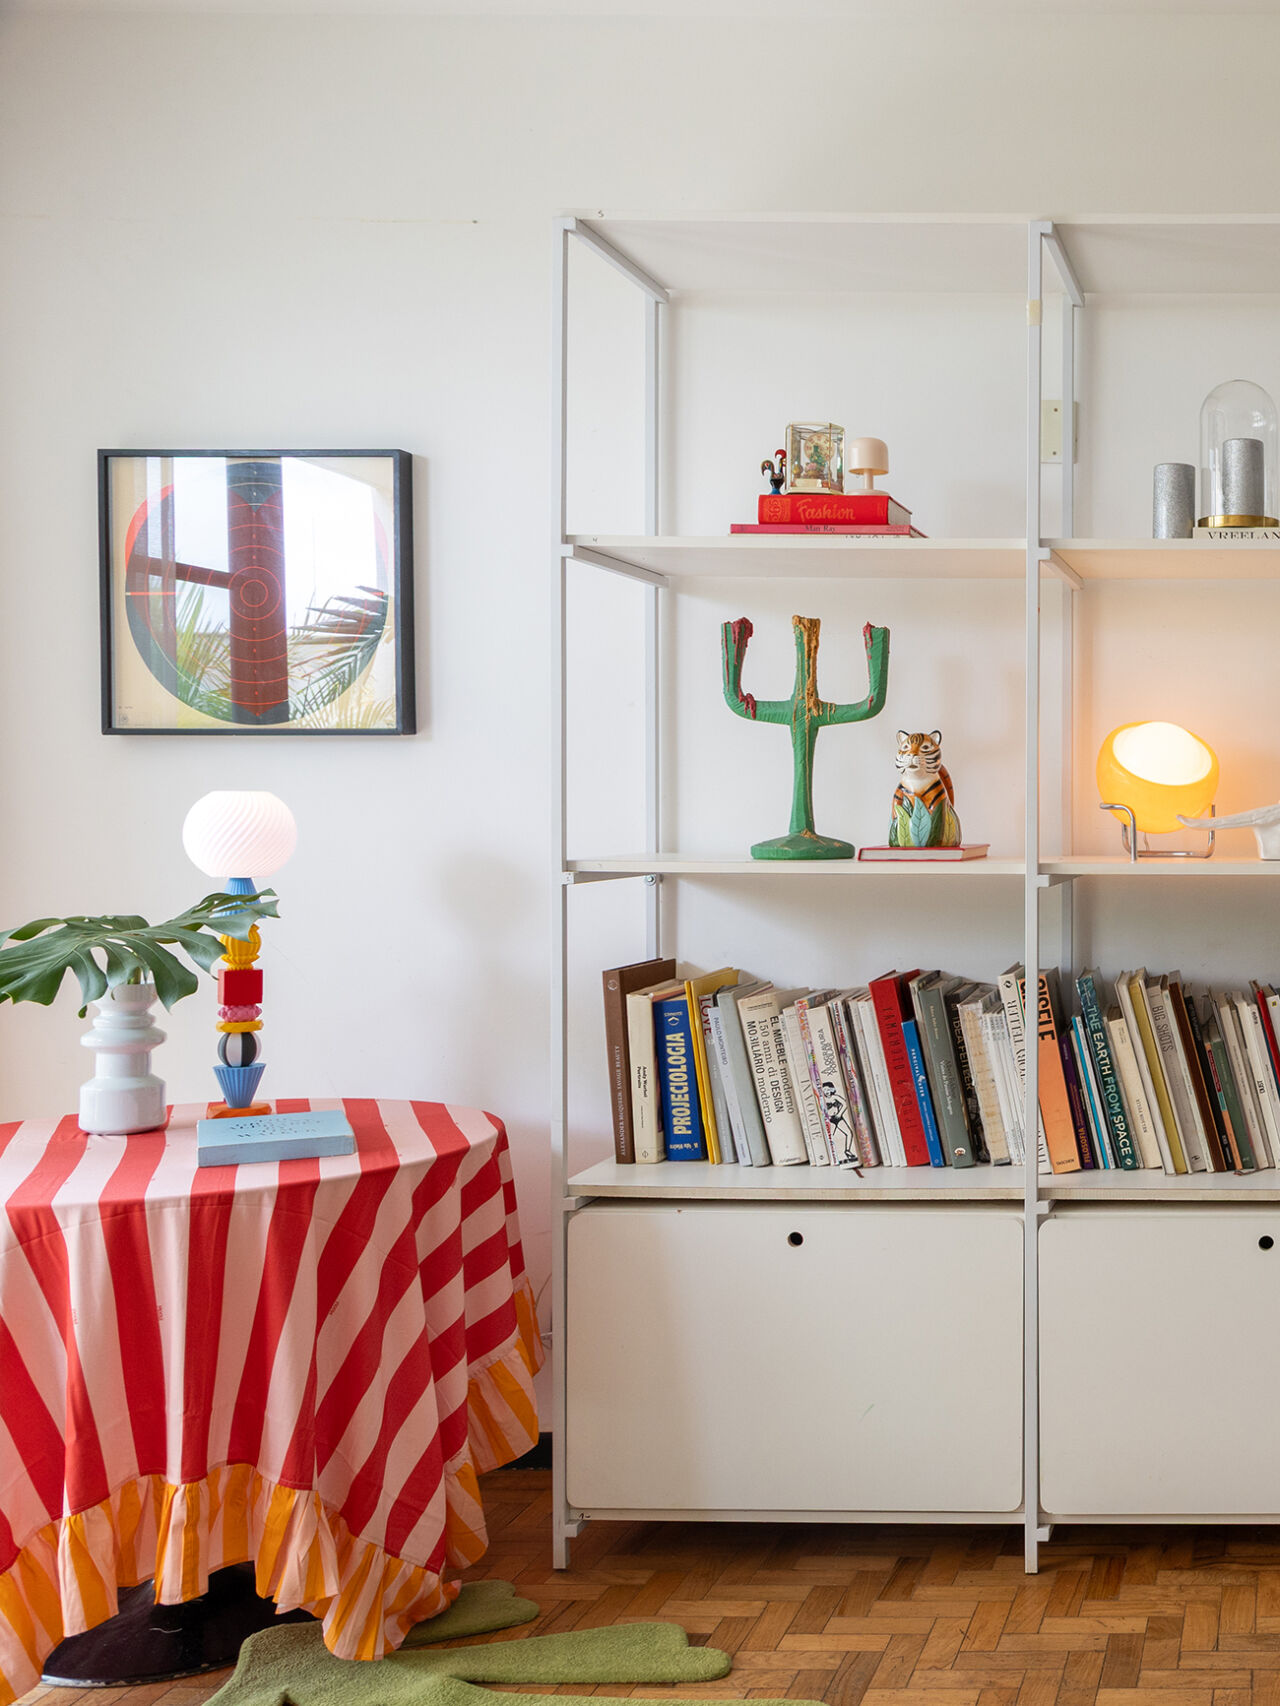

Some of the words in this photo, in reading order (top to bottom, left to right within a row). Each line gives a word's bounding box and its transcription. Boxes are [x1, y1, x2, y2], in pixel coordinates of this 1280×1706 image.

[796, 498, 856, 522] Fashion
[823, 525, 836, 534] Ray
[700, 998, 712, 1036] LOVE
[714, 1016, 722, 1035] PAULO
[758, 1019, 770, 1038] 150
[770, 1015, 779, 1027] EL
[1006, 1000, 1025, 1047] TELLER
[1087, 1005, 1101, 1031] THE
[1152, 1005, 1166, 1022] BIG
[717, 1036, 729, 1066] MONTEIRO
[762, 1039, 773, 1064] anni
[772, 1027, 788, 1066] MUEBLE
[883, 1007, 905, 1071] YAMAMOTO
[1093, 1032, 1112, 1076] EARTH
[1158, 1022, 1174, 1053] SHOTS
[767, 1064, 778, 1078] di
[911, 1048, 921, 1077] PERCIVAL
[665, 1032, 692, 1135] PROJECIOLOGIA
[757, 1076, 773, 1124] moderno
[770, 1079, 785, 1114] DESIGN
[780, 1065, 795, 1114] moderno
[800, 1079, 811, 1092] IN
[1103, 1076, 1121, 1113] FROM
[803, 1092, 823, 1141] VOGUE
[1078, 1127, 1091, 1163] FILOSOFIA
[1113, 1114, 1132, 1157] SPACE
